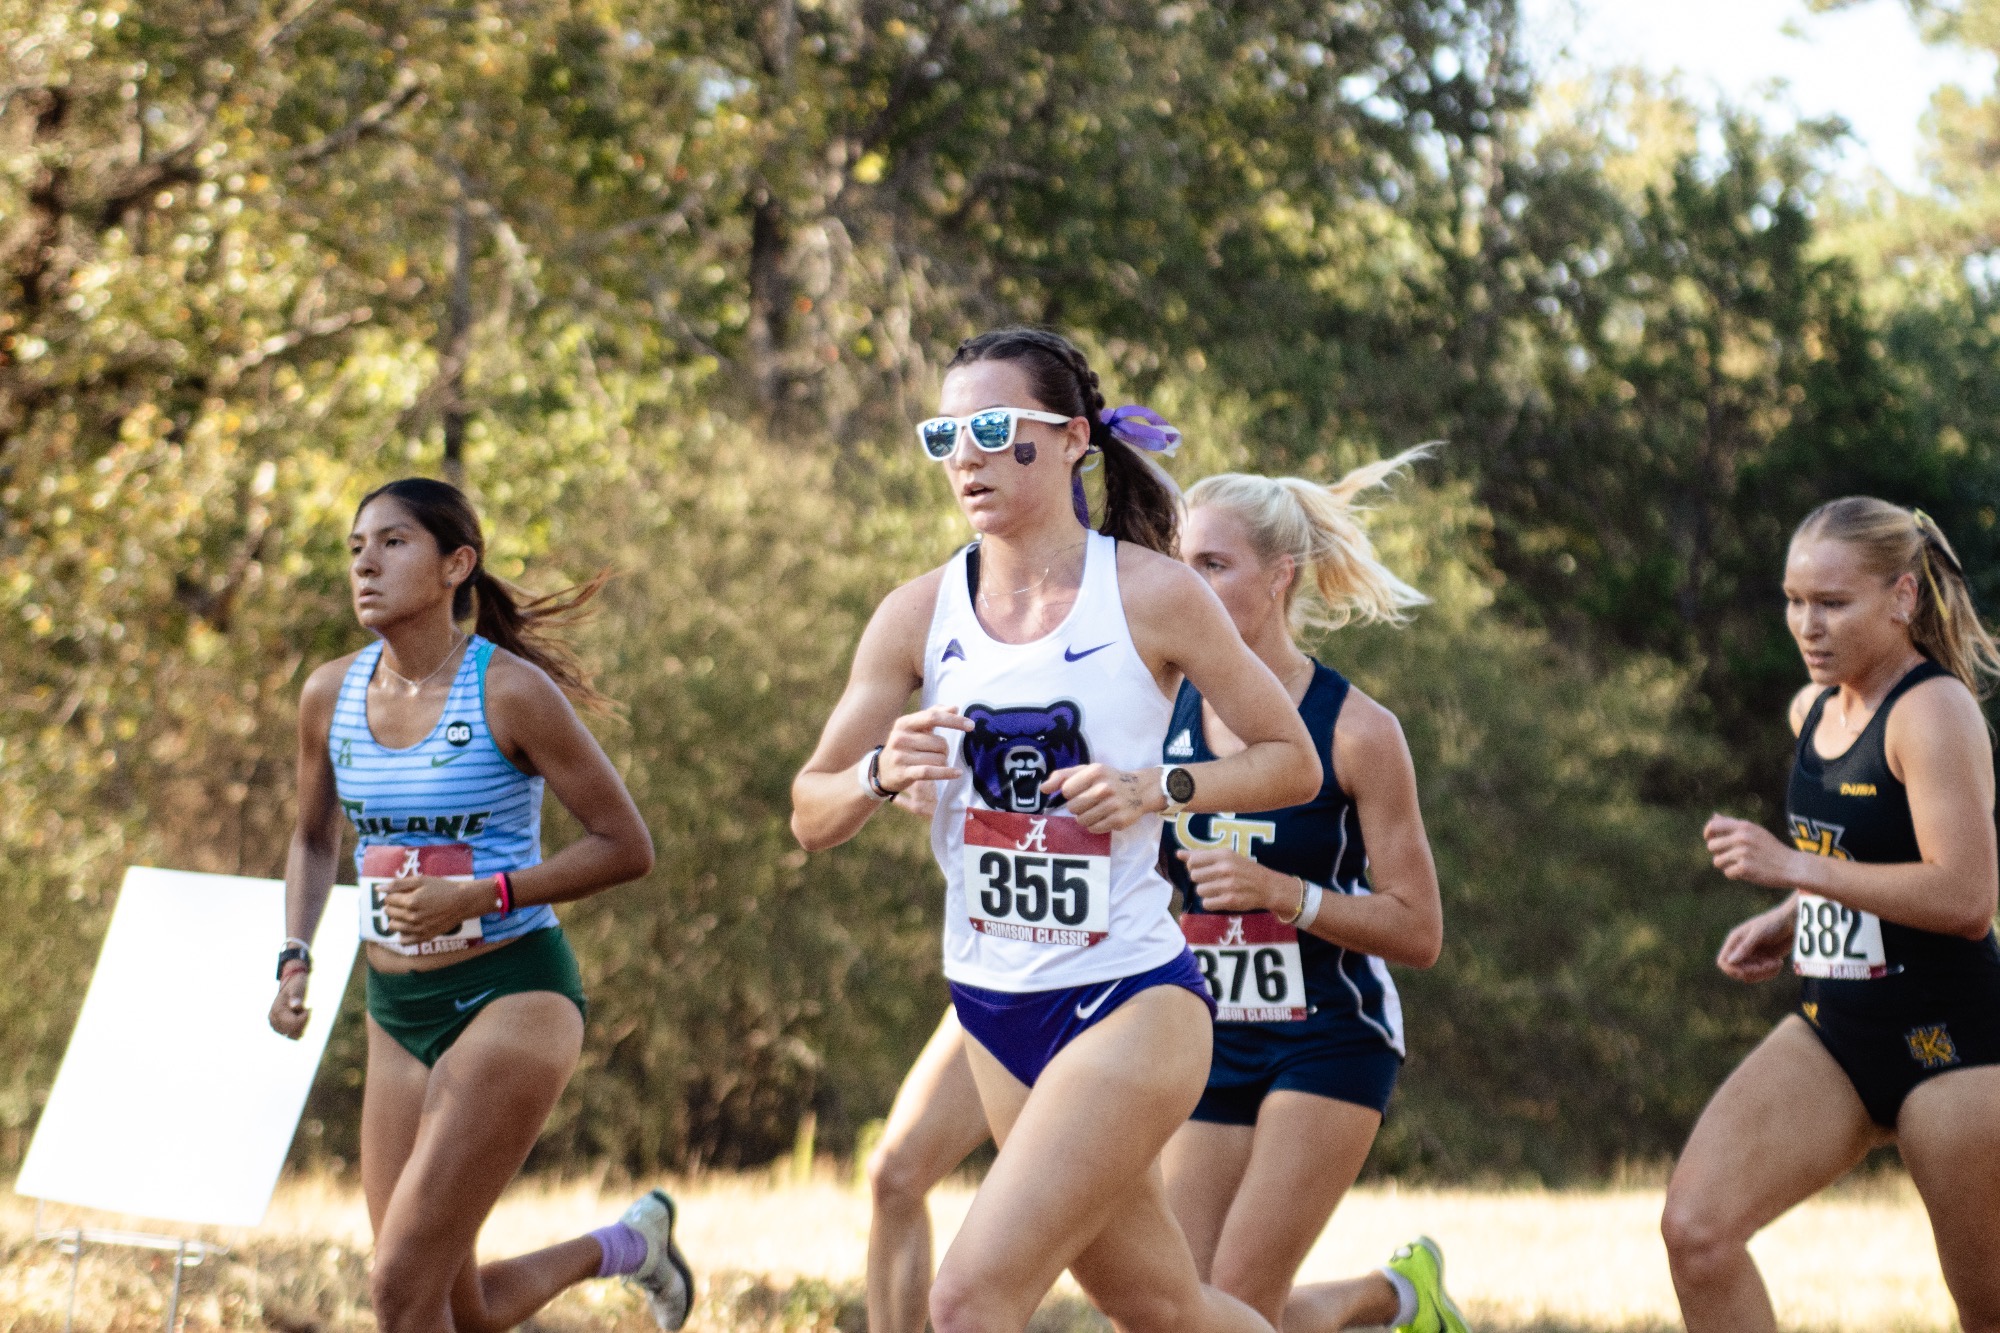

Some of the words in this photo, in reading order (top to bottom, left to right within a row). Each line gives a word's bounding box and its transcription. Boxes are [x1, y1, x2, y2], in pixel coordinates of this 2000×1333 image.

[1015, 817, 1048, 852] A
[979, 850, 1090, 926] 355
[983, 920, 1034, 942] CRIMSON
[1036, 927, 1090, 947] CLASSIC
[1219, 915, 1247, 945] A
[1799, 902, 1868, 959] 382
[1247, 1008, 1292, 1021] CLASSIC
